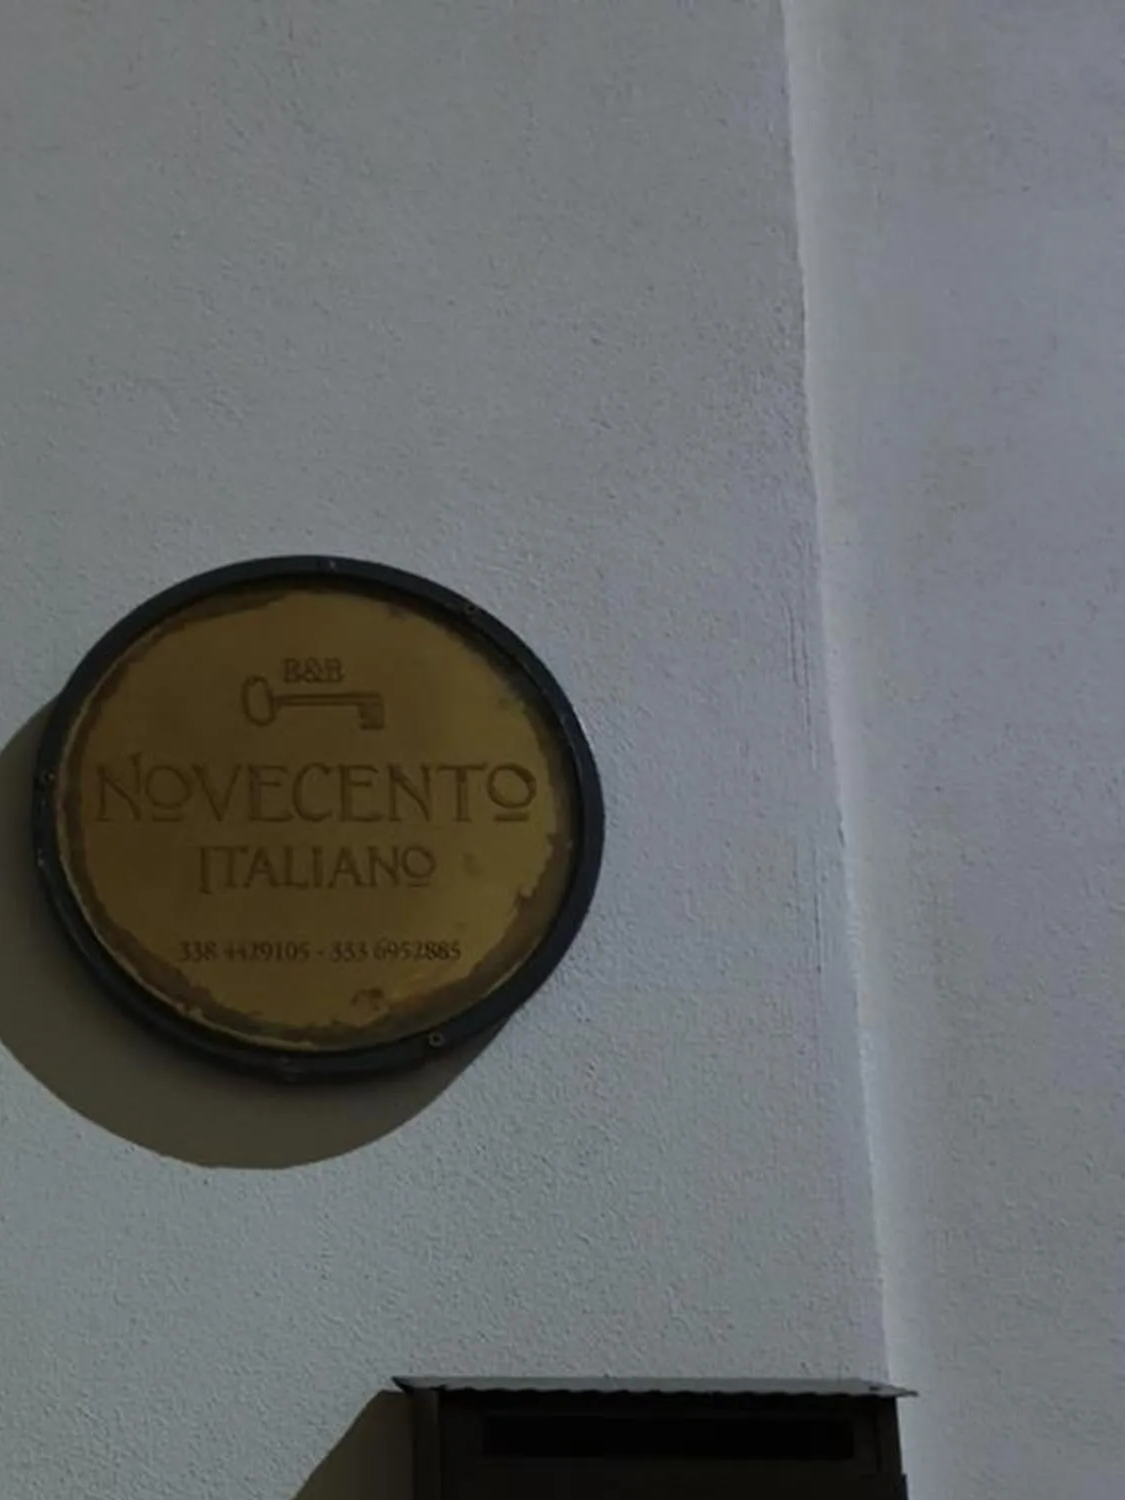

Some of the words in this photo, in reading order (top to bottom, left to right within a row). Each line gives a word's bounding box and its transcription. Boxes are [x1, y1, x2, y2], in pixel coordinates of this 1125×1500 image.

[283, 657, 344, 683] B&B
[94, 751, 538, 823] NOVECENTO
[196, 845, 437, 894] ITALIANO
[178, 939, 217, 962] 338
